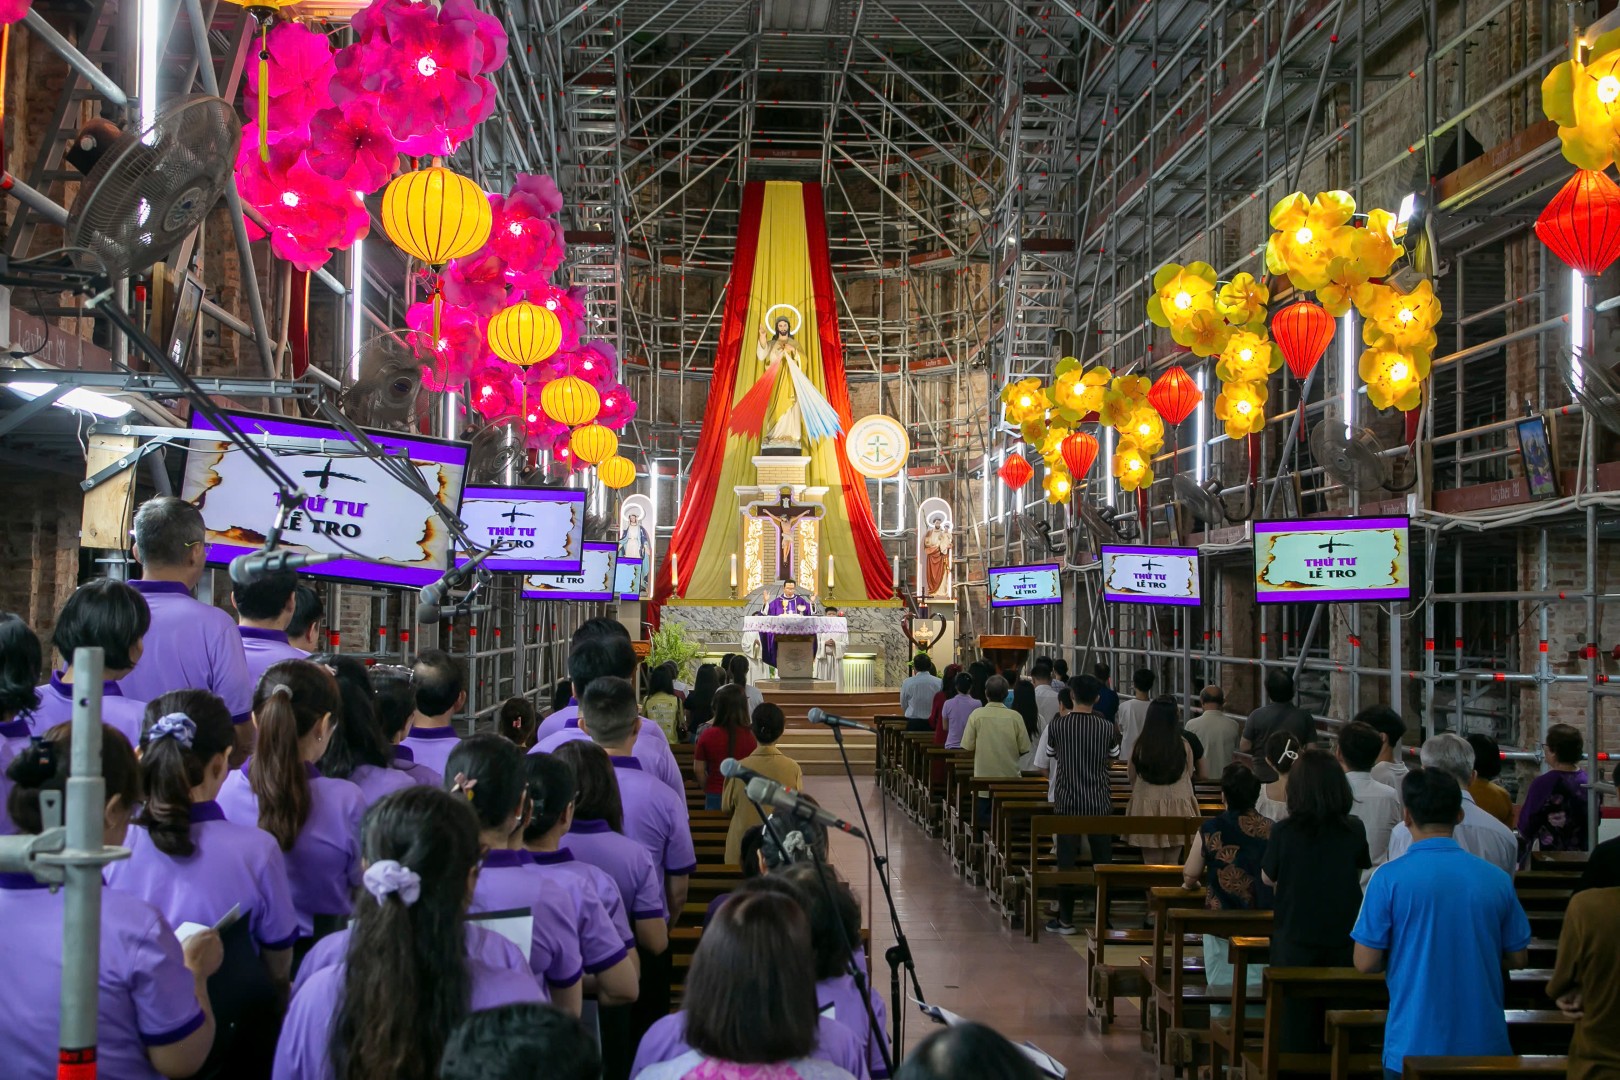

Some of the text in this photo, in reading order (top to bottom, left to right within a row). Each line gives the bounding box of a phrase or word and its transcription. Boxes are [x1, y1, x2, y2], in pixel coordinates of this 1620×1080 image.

[309, 519, 362, 538] TRO
[507, 539, 534, 549] TRO
[1327, 569, 1357, 578] TRO
[1147, 581, 1167, 589] TRO
